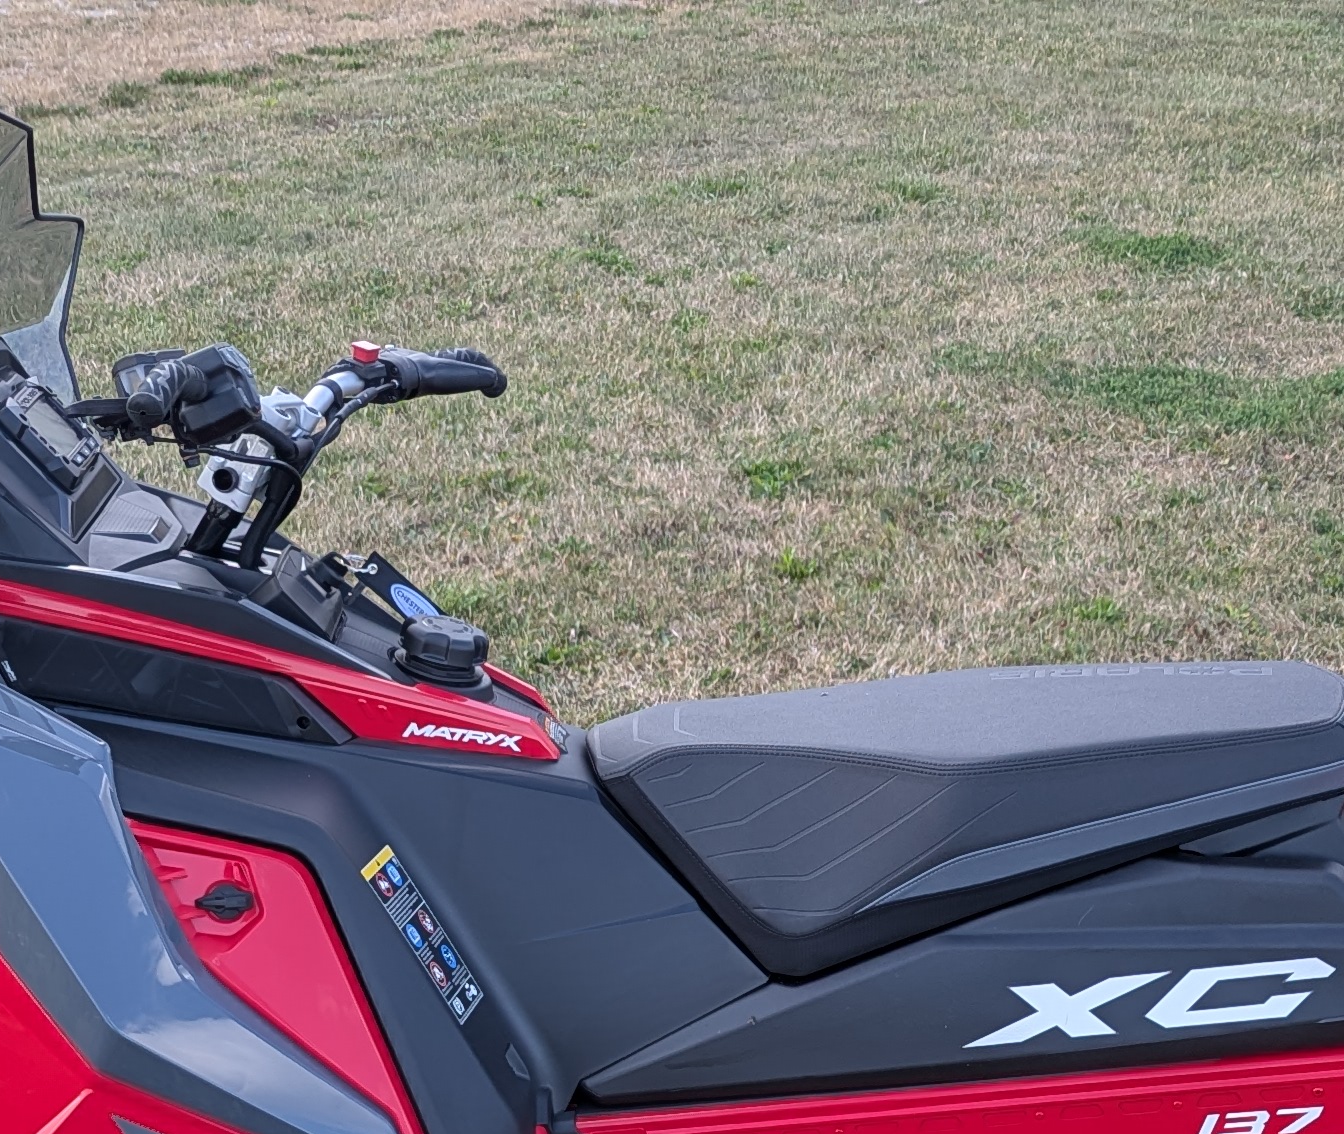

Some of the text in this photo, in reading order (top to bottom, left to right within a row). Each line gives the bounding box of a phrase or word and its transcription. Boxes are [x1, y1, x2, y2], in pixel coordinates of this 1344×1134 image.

[396, 590, 428, 616] CHESTER
[402, 712, 522, 752] MATRYX
[962, 957, 1336, 1048] XC
